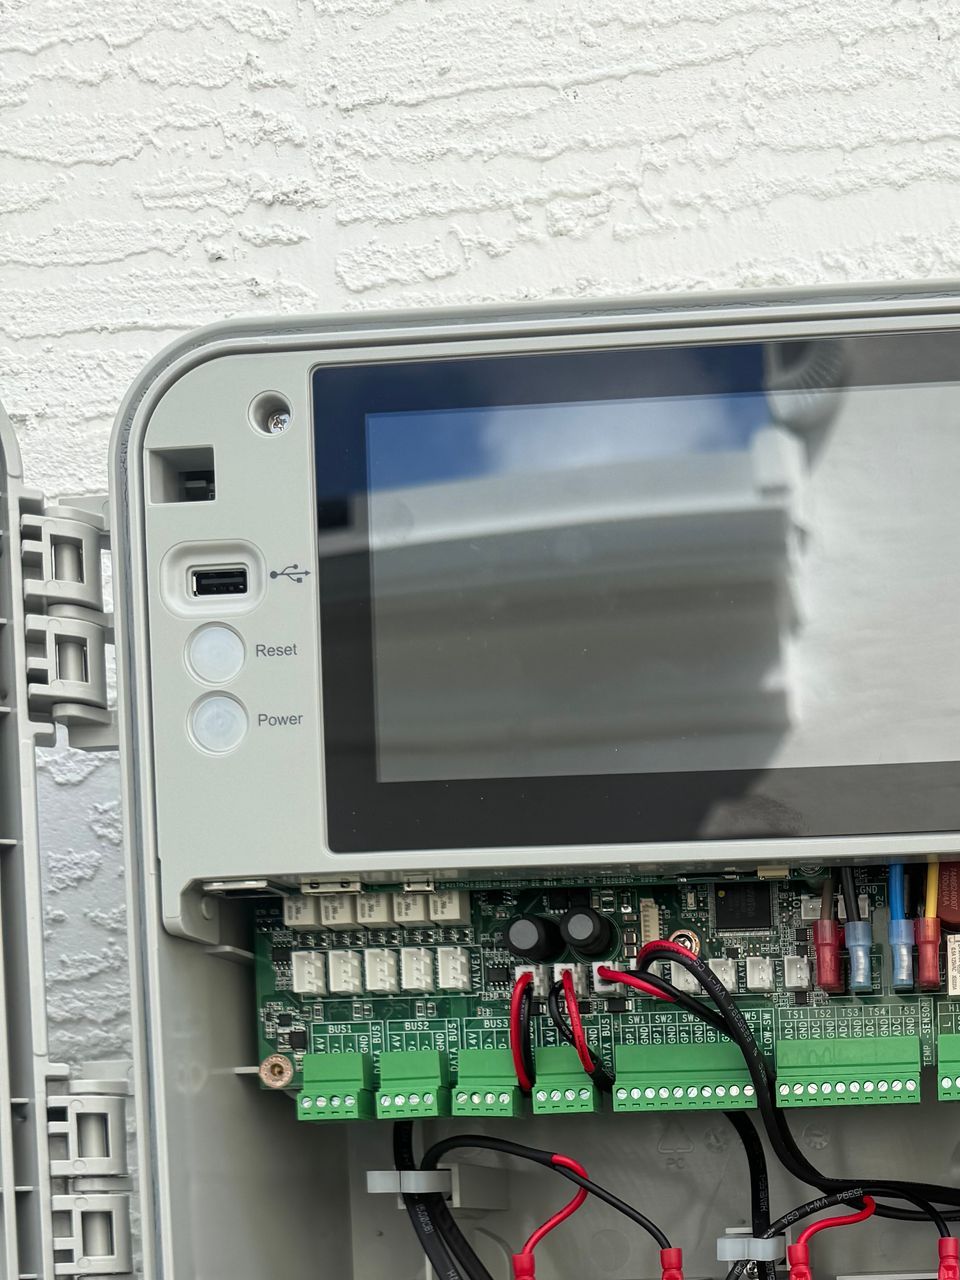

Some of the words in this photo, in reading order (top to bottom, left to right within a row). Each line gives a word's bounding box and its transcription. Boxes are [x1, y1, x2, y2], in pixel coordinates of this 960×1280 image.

[255, 643, 298, 657] Reset
[257, 713, 304, 727] Power
[743, 1012, 757, 1020] W5
[787, 1011, 804, 1019] TS1
[814, 1010, 831, 1018] TS2
[841, 1008, 859, 1017] TS3
[869, 1007, 886, 1016] TS4
[899, 1006, 916, 1015] TS5
[949, 1004, 960, 1012] H1
[404, 1022, 429, 1031] BUS2
[483, 1020, 508, 1028] BUS3
[602, 1018, 610, 1037] BUS
[628, 1015, 645, 1024] SW1
[655, 1014, 673, 1023] SW2
[893, 1018, 901, 1036] ADC
[907, 1017, 915, 1035] GND
[328, 1025, 352, 1034] BUS1
[372, 1025, 381, 1043] BUS
[449, 1023, 457, 1041] BUS
[590, 1028, 598, 1046] GND
[626, 1028, 634, 1044] GPI
[641, 1026, 649, 1044] GND
[654, 1027, 662, 1044] GPI
[668, 1025, 676, 1043] GND
[681, 1026, 689, 1043] GPI
[695, 1025, 703, 1043] GND
[763, 1012, 772, 1055] FLOW-SW
[785, 1022, 793, 1040] ADC
[799, 1021, 807, 1039] GND
[812, 1021, 820, 1039] ADC
[827, 1021, 835, 1039] GND
[839, 1020, 847, 1038] ADC
[854, 1020, 862, 1037] GND
[866, 1019, 874, 1037] ADC
[881, 1019, 889, 1037] GND
[360, 1035, 368, 1053] GND
[436, 1033, 445, 1051] GND
[468, 1033, 477, 1050] 14V
[450, 1047, 458, 1071] DATA
[603, 1042, 612, 1067] DATA
